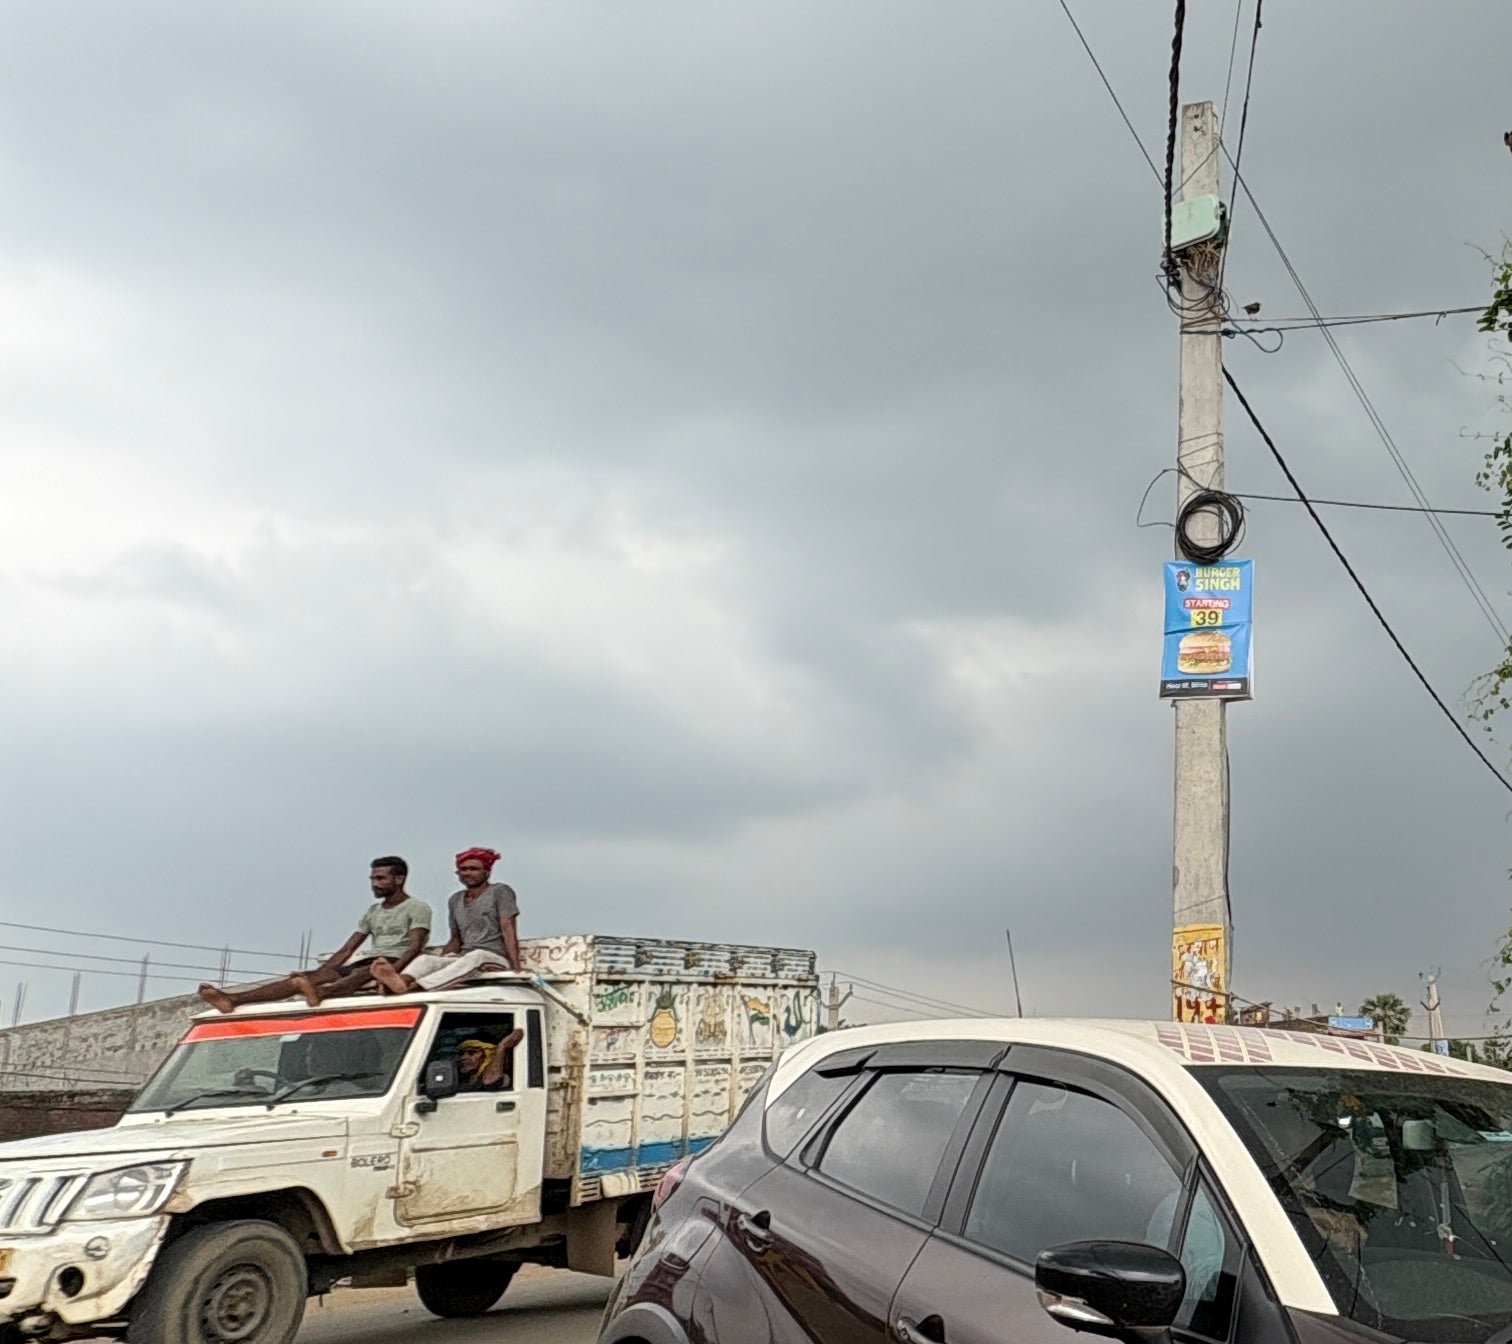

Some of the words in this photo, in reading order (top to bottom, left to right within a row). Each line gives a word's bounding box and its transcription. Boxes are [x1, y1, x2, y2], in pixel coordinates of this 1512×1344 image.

[1195, 567, 1240, 578] BURGER
[1195, 578, 1240, 591] SINGH
[1184, 599, 1230, 609] STARTING
